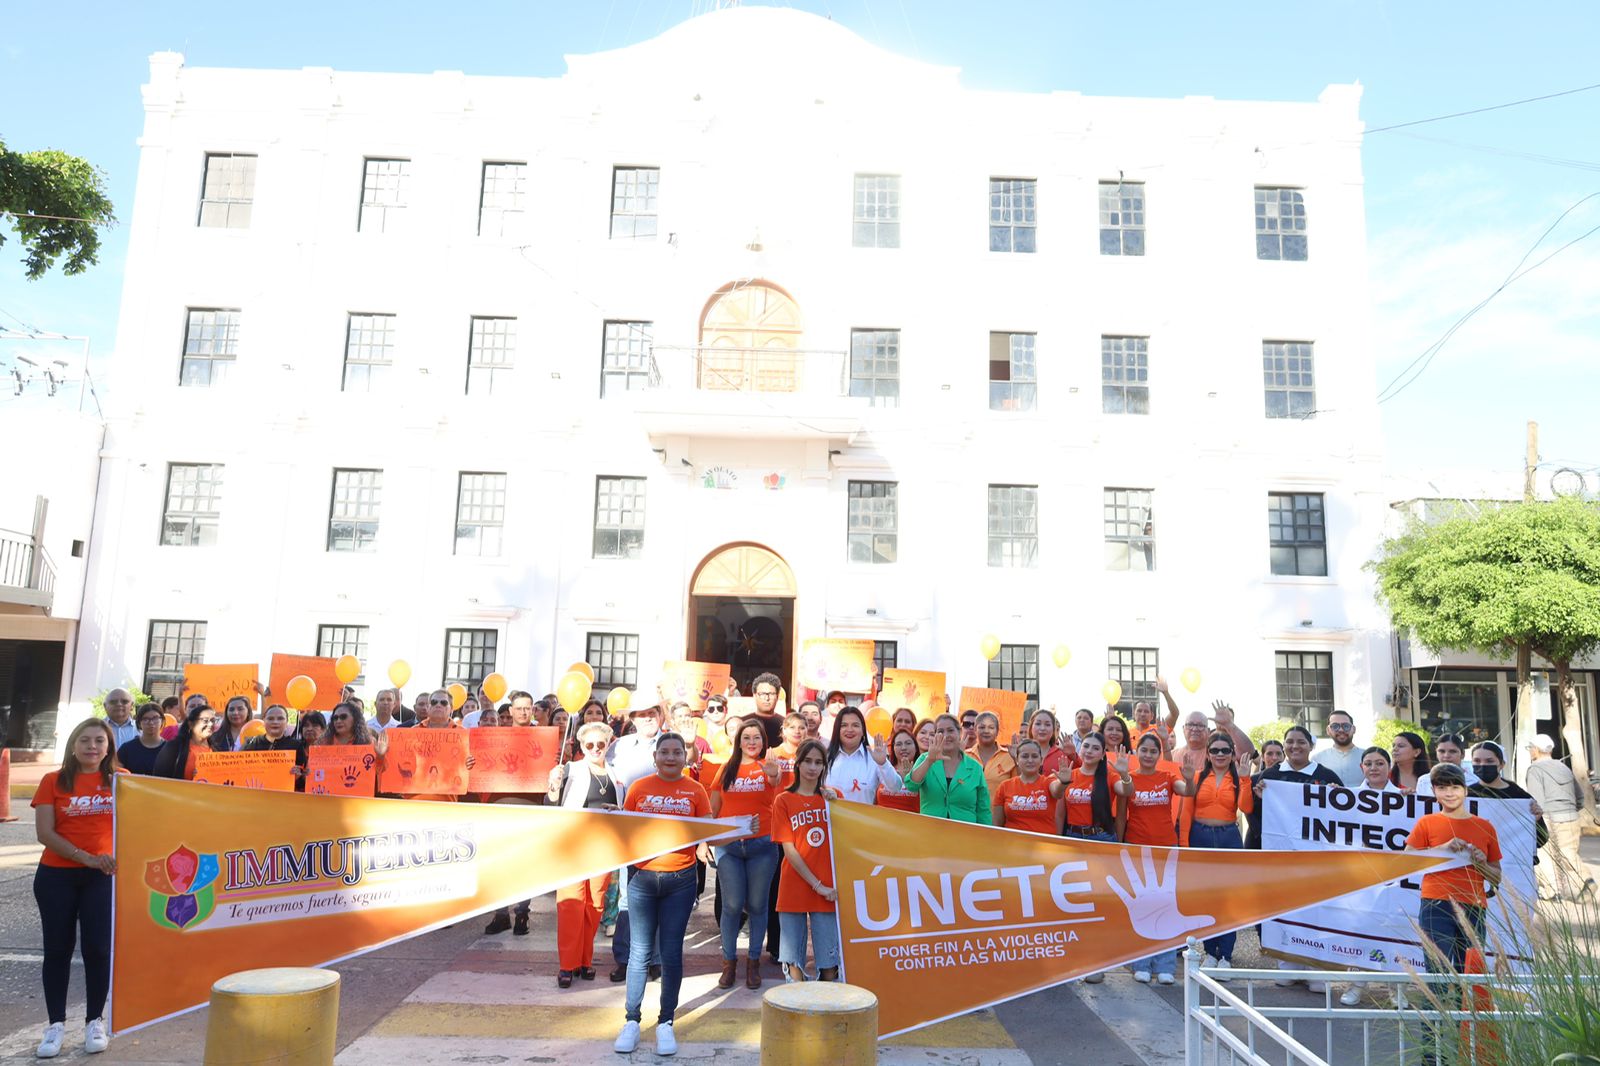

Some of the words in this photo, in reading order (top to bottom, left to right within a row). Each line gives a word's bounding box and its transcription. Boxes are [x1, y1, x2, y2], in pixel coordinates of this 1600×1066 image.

[224, 826, 477, 891] IMMUJERES
[229, 902, 243, 919] Te
[246, 898, 304, 920] queremos
[305, 894, 347, 914] fuerte,
[351, 889, 392, 905] segura
[853, 861, 1096, 932] ÚNETE
[878, 943, 931, 960] PONER
[934, 941, 959, 954] FIN
[962, 939, 975, 952] A
[976, 937, 997, 951] LA
[999, 930, 1079, 949] VIOLENCIA
[895, 956, 957, 972] CONTRA
[960, 951, 990, 966] LAS
[993, 945, 1066, 964] MUJERES
[1291, 936, 1325, 950] SINALOA
[1331, 944, 1363, 956] SALUD
